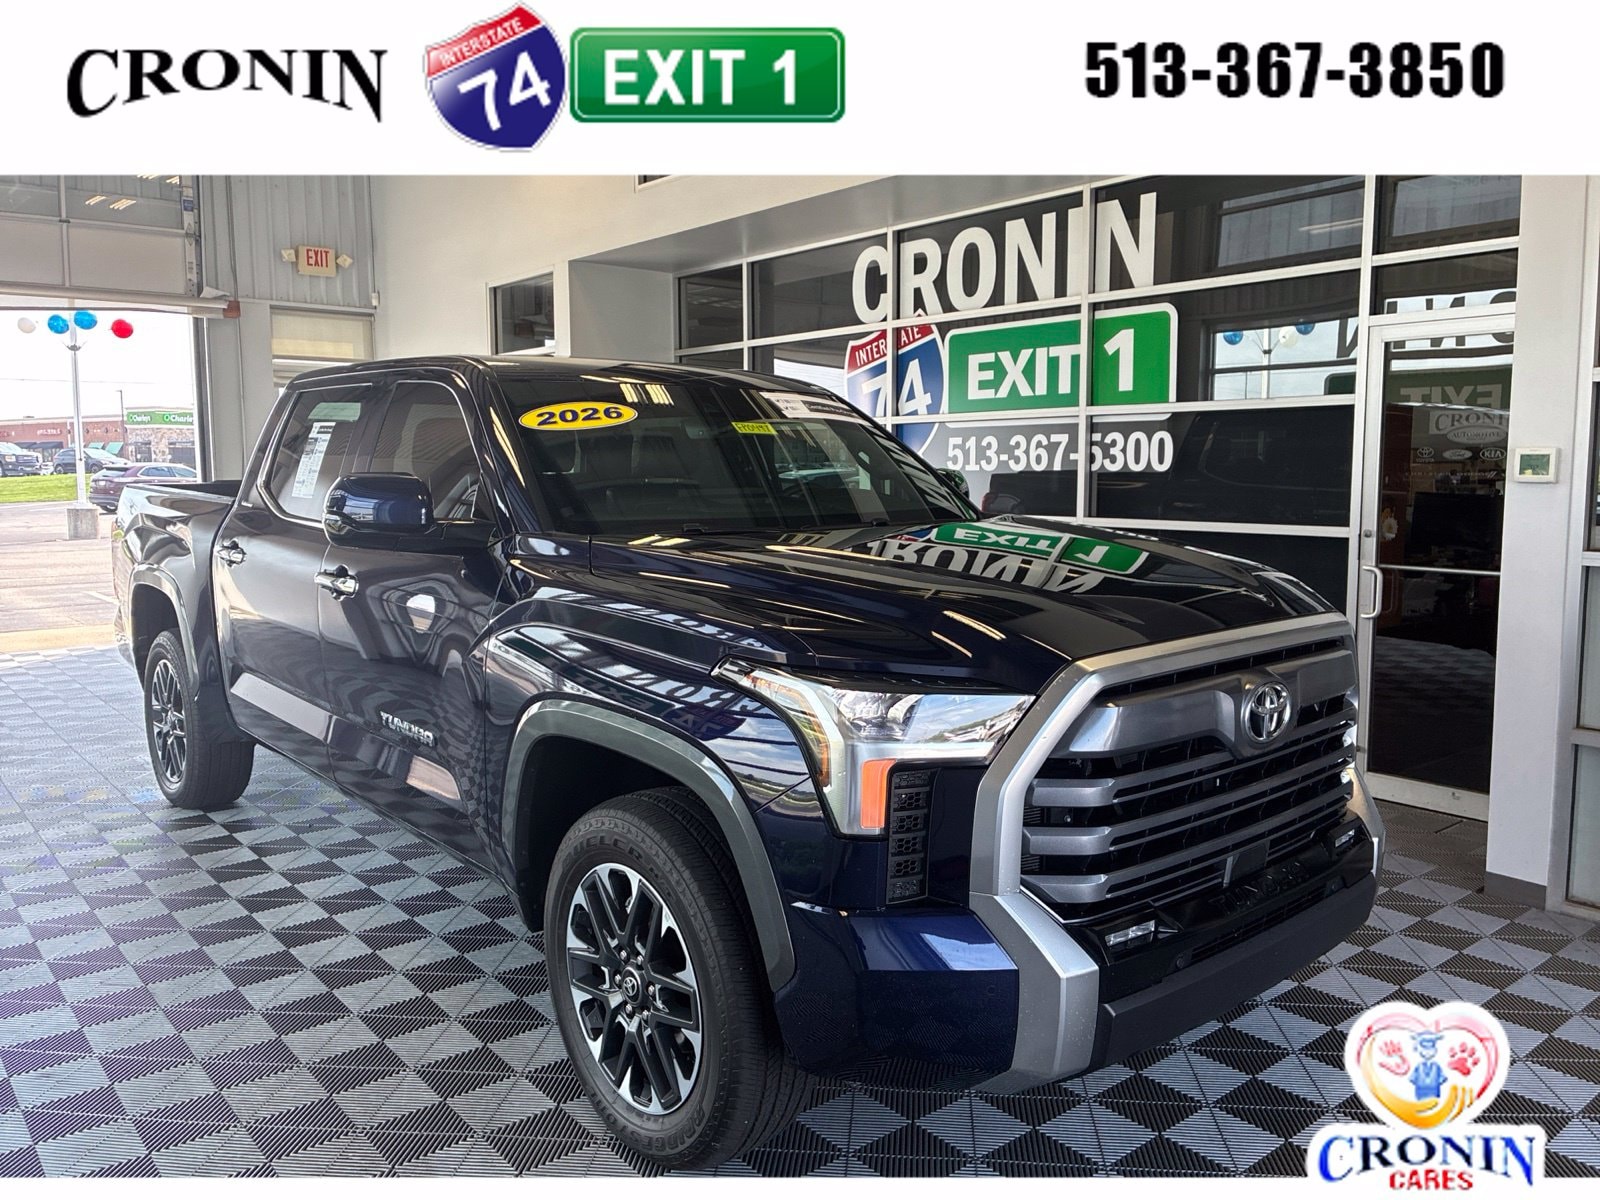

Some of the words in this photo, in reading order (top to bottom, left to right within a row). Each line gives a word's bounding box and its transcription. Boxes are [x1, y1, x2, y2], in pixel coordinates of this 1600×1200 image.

[306, 248, 330, 268] EXIT
[852, 192, 1157, 324] CRONIN
[855, 326, 922, 367] INTERATE
[967, 343, 1081, 400] EXIT
[1103, 328, 1134, 392] 1
[861, 359, 932, 417] 74
[536, 406, 624, 426] 2026
[1435, 412, 1509, 432] CRONI
[380, 710, 434, 747] TUNDRA
